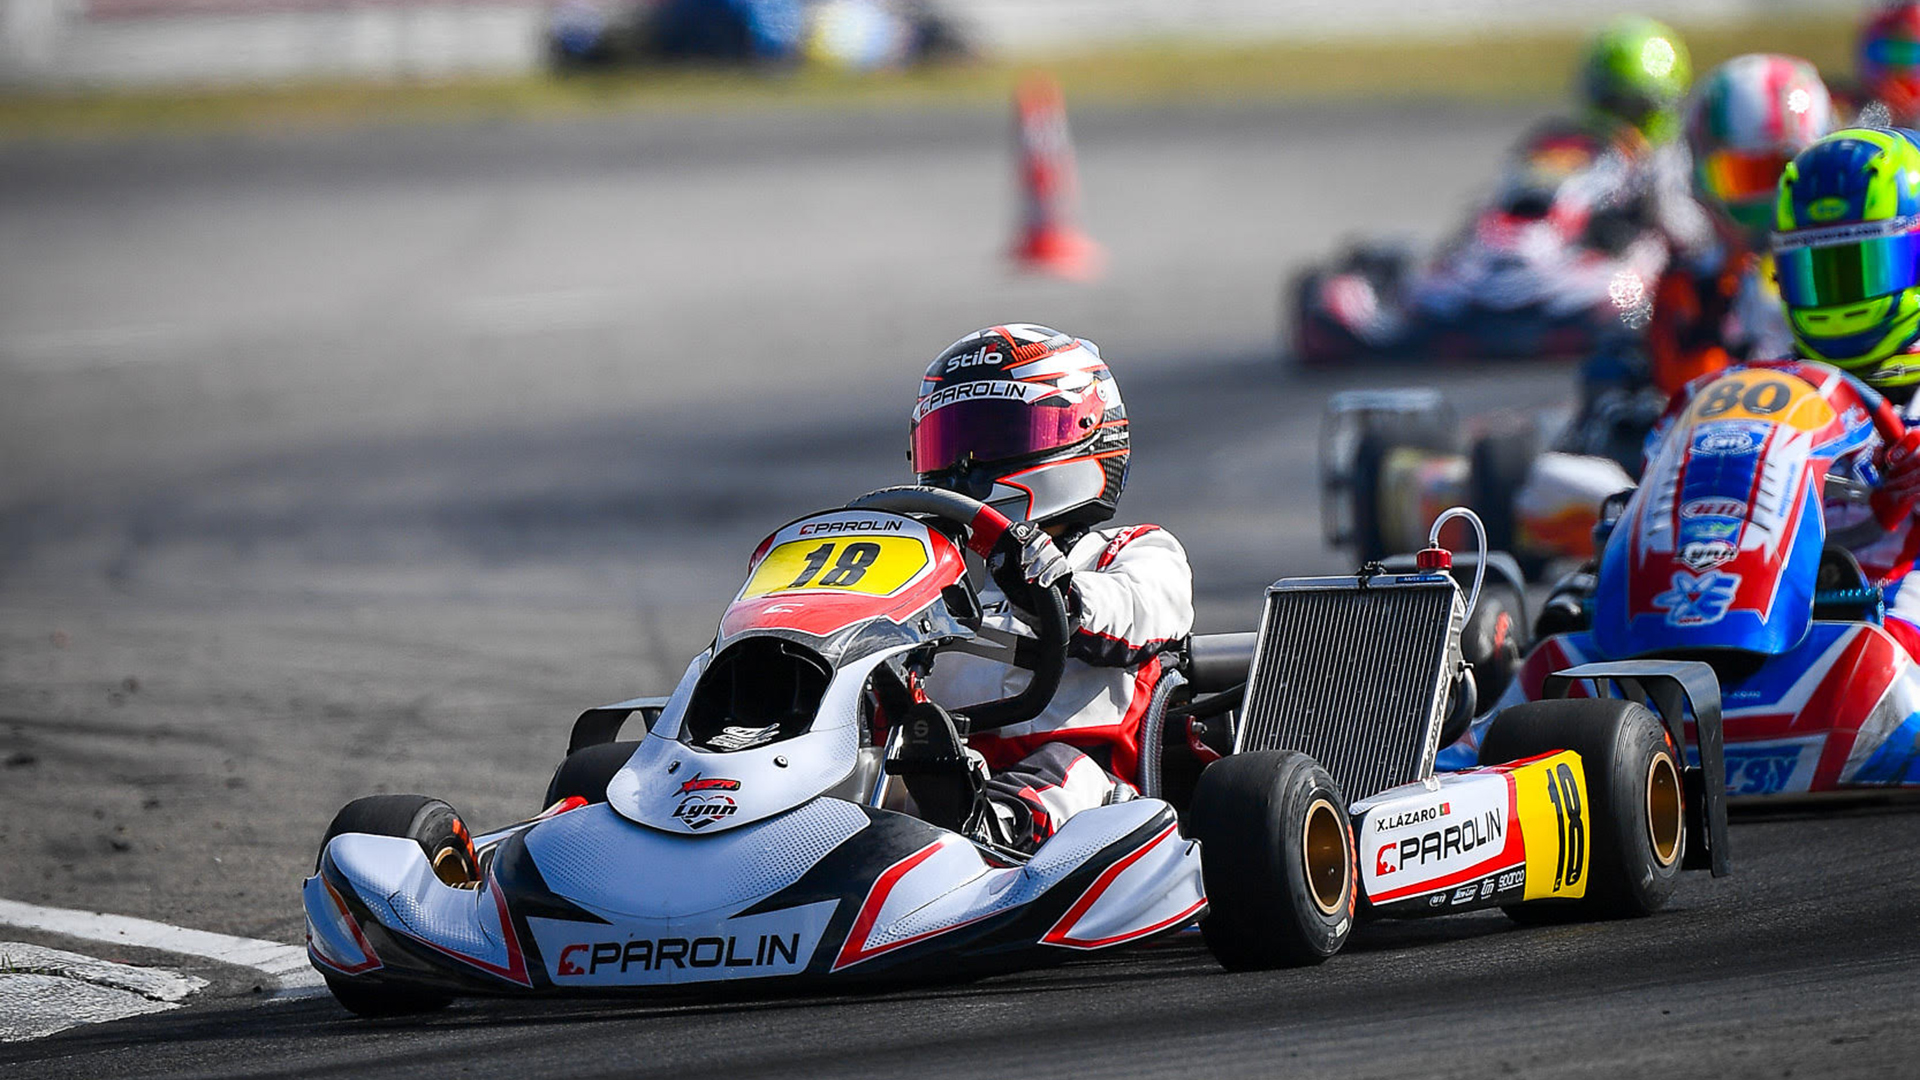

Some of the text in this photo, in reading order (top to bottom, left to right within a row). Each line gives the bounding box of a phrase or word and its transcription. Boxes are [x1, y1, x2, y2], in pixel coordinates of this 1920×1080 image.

[946, 344, 1003, 373] Stilo
[1697, 381, 1791, 417] 80
[788, 542, 881, 588] 18
[672, 804, 738, 819] Lynn
[1547, 762, 1585, 893] 18
[1498, 869, 1525, 891] sparco
